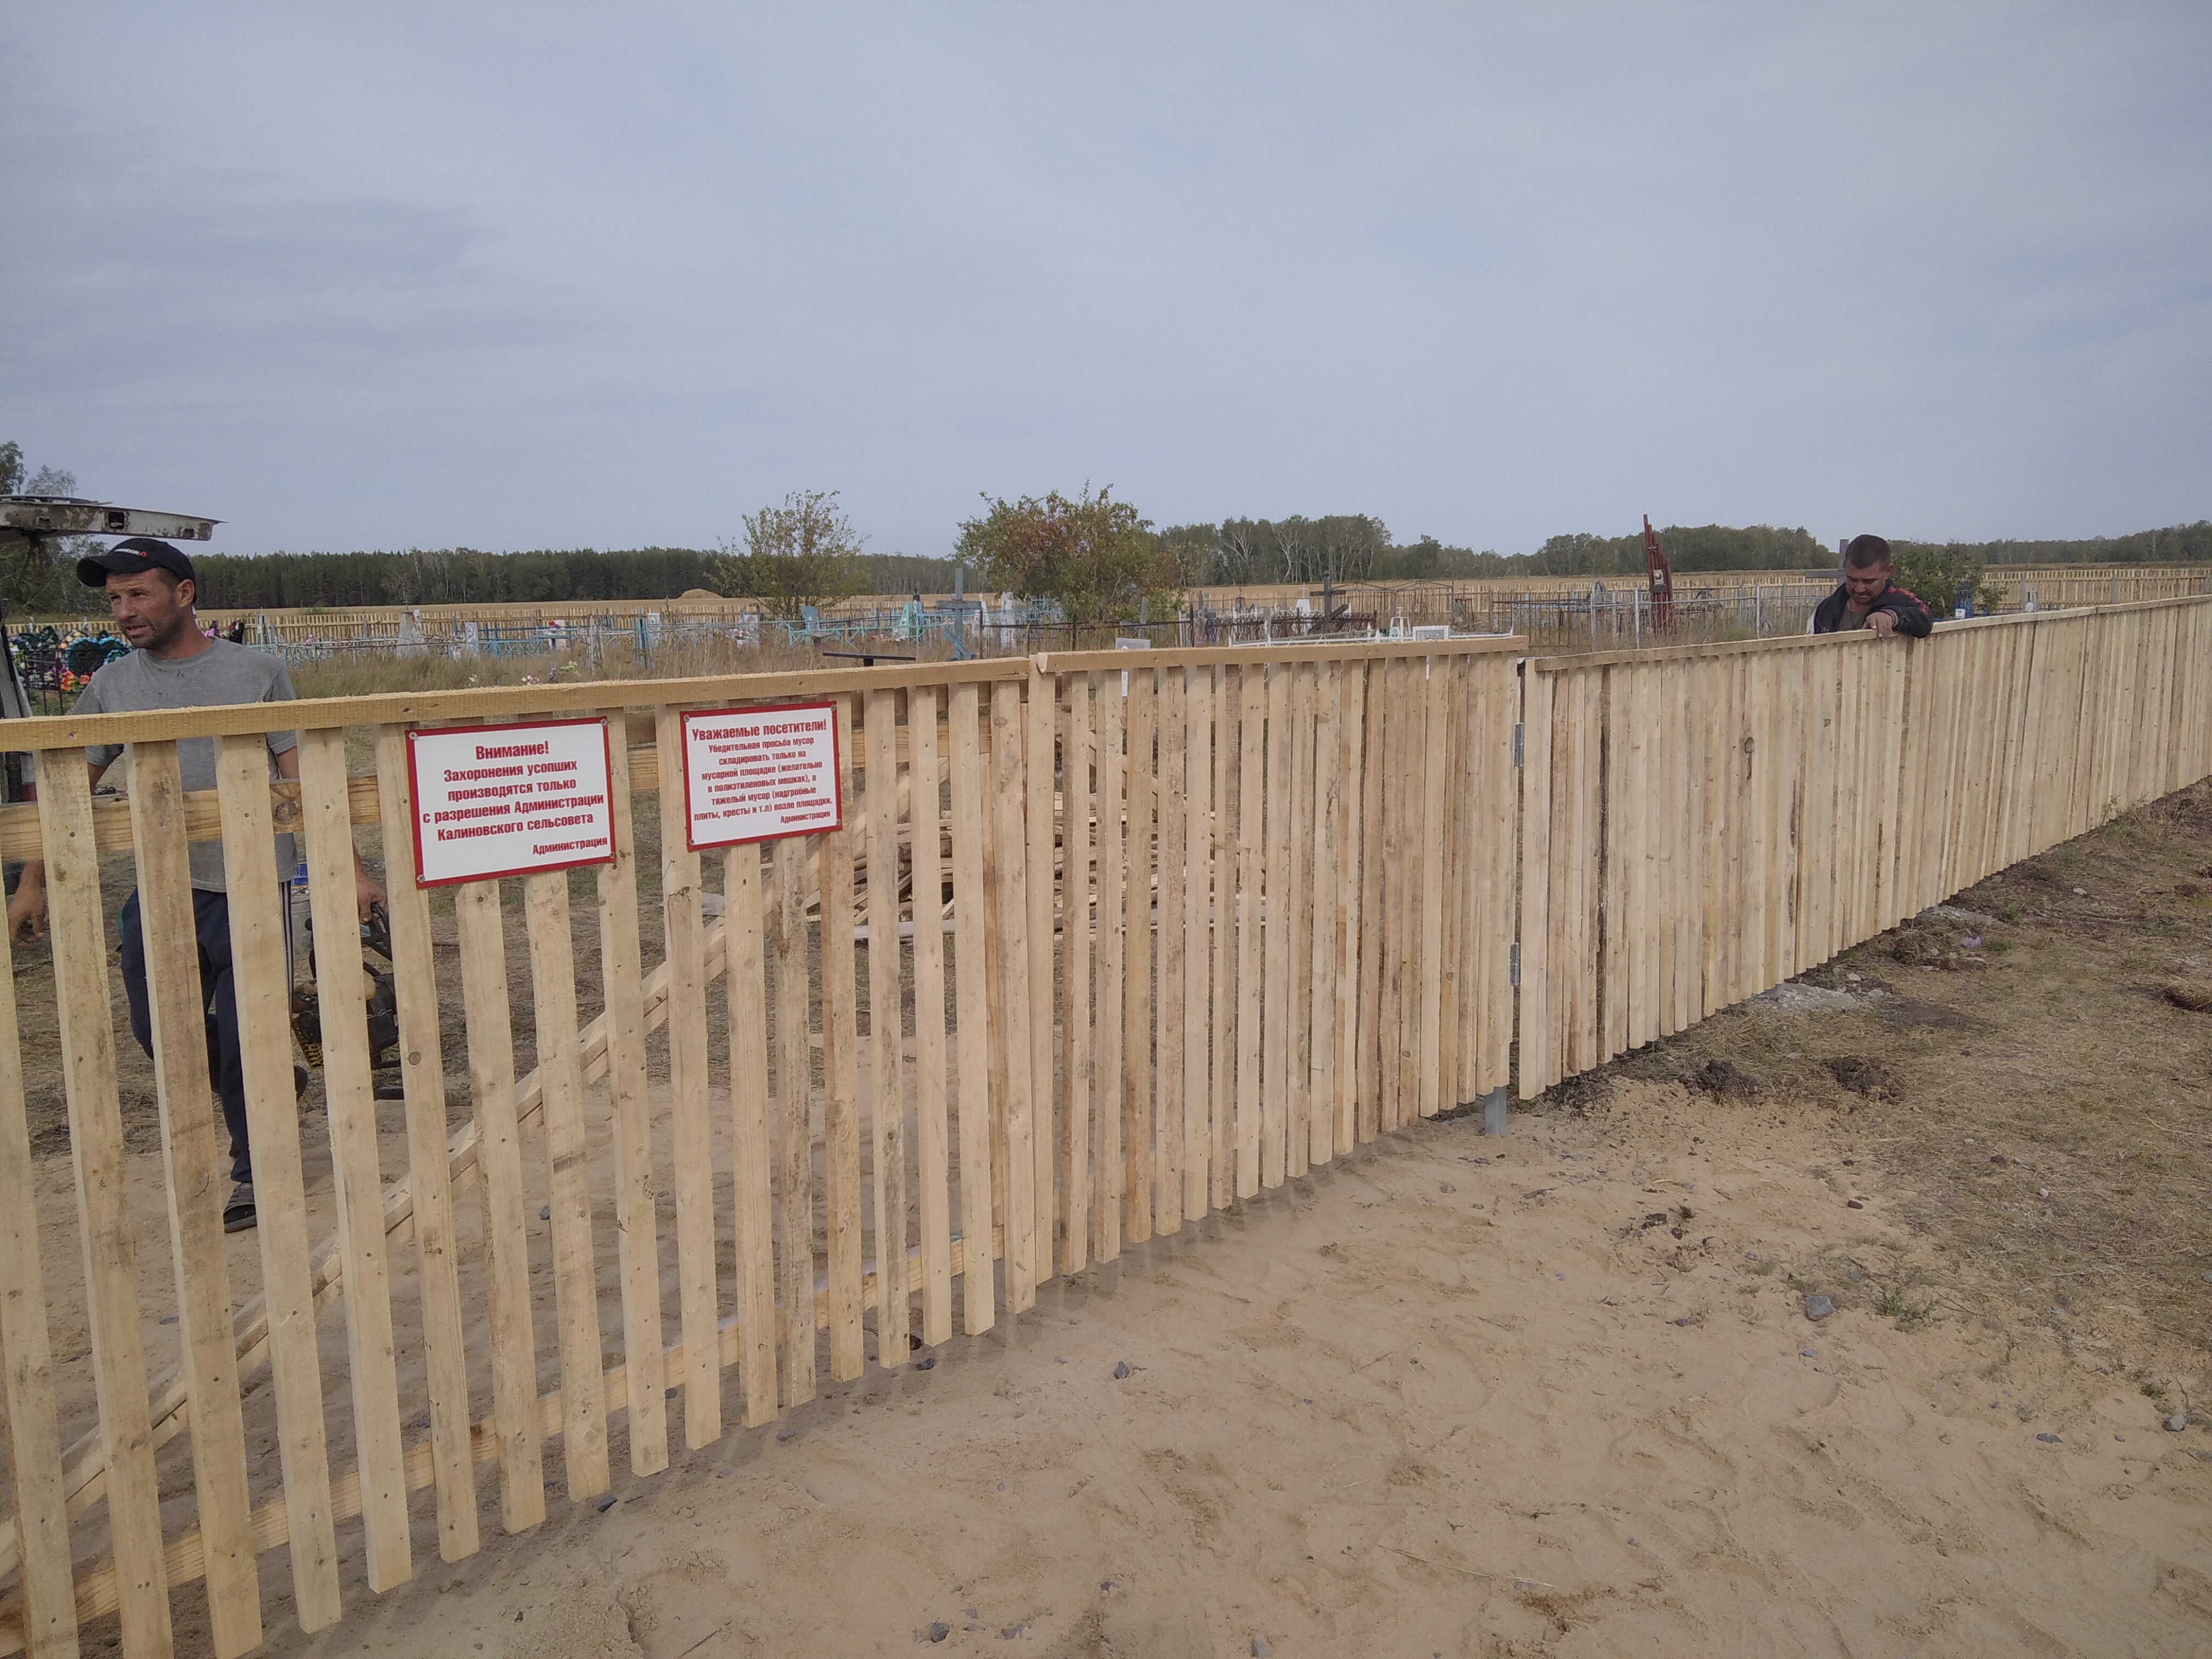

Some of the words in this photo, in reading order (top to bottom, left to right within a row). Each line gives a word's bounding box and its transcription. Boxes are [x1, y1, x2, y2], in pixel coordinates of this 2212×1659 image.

[692, 726, 761, 741] Уважаемые
[763, 719, 827, 736] посетители!
[476, 740, 550, 760] Внимание!
[709, 742, 761, 753] Убедительная
[763, 740, 792, 749] просьба
[793, 737, 815, 746] мусор
[719, 754, 770, 765] складировать
[772, 752, 797, 760] только
[444, 765, 524, 782] Захоронения
[527, 761, 578, 776] усопших
[702, 770, 739, 781] мусорной
[740, 766, 777, 776] площадке
[778, 761, 823, 772] (желательно
[448, 783, 534, 803] производятся
[537, 779, 578, 792] только
[715, 778, 776, 792] полиэтиленовых
[712, 795, 747, 805] тяжелый
[748, 792, 771, 802] мусор
[772, 787, 817, 799] (надгробные
[423, 813, 431, 823] с
[435, 804, 511, 825] разрешения
[515, 794, 605, 815] Администрации
[695, 812, 721, 821] плиты,
[723, 808, 751, 817] кресты
[774, 802, 795, 811] возле
[797, 798, 833, 808] площадки.
[781, 811, 831, 824] Администрация
[438, 821, 524, 841] Калиновского
[527, 814, 594, 831] сельсовета
[533, 837, 608, 855] Администрация
